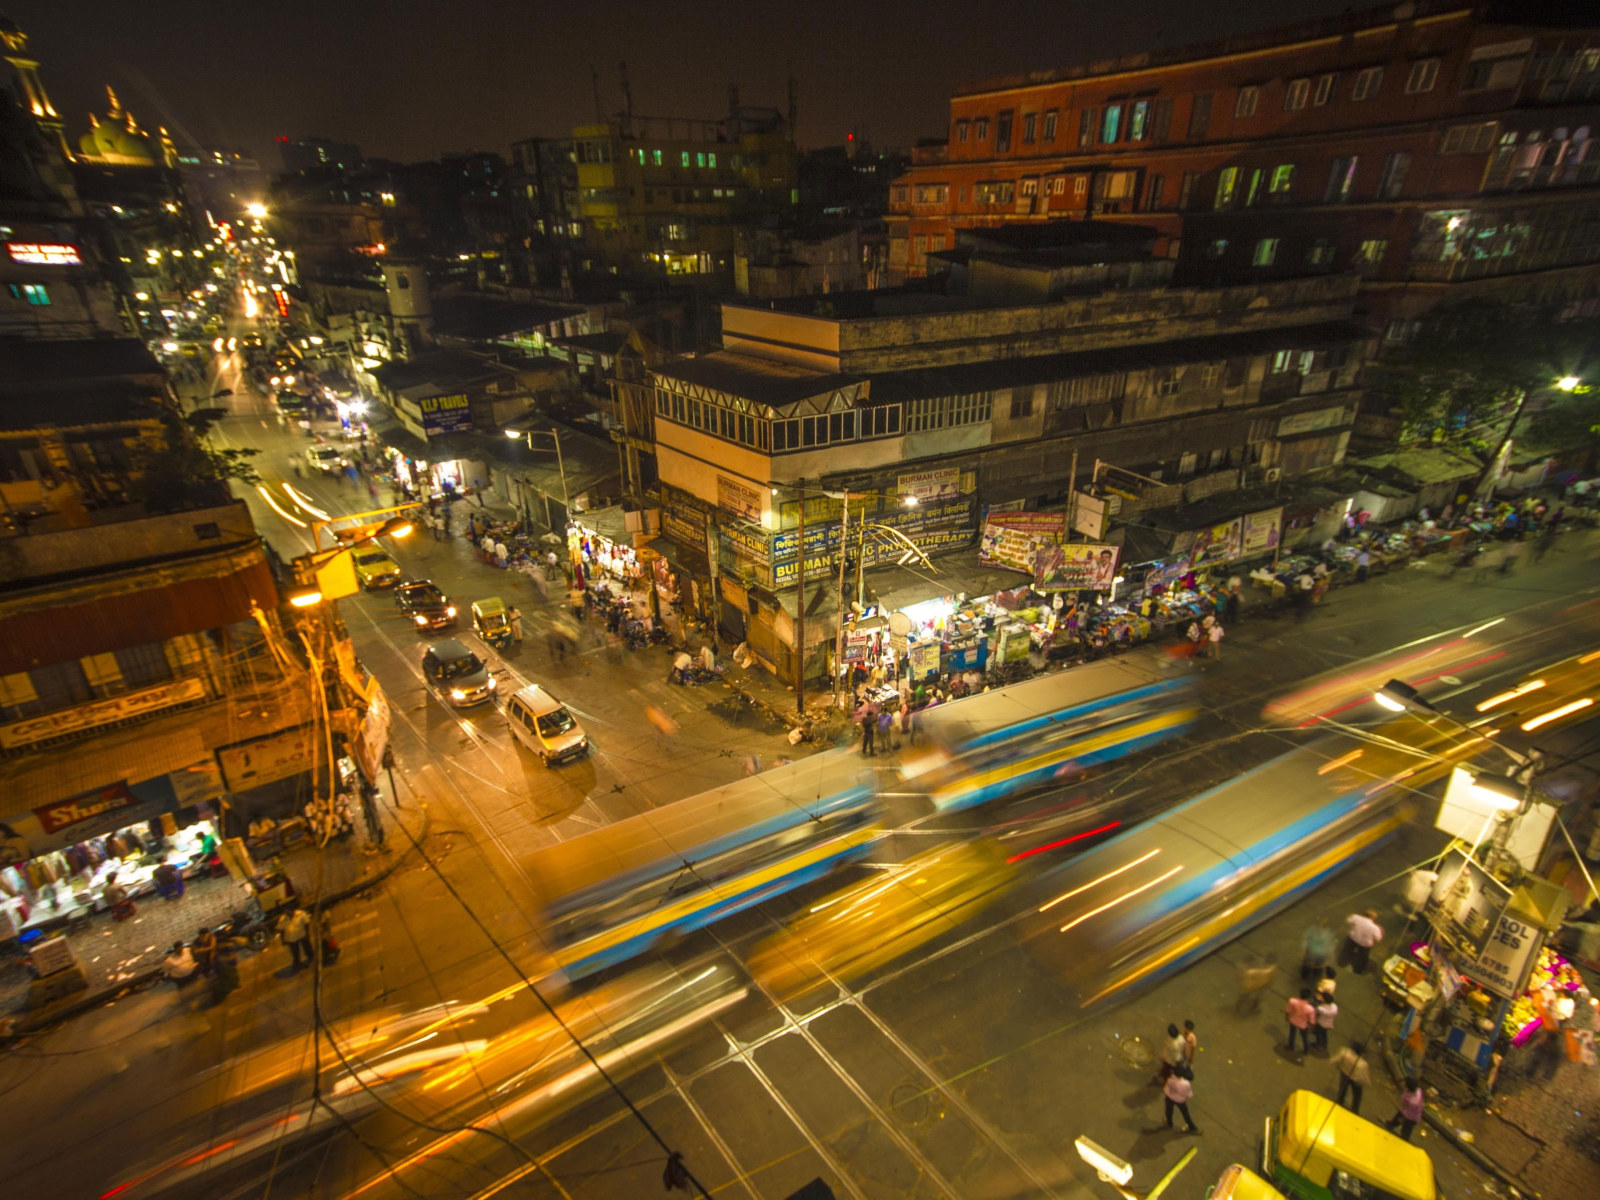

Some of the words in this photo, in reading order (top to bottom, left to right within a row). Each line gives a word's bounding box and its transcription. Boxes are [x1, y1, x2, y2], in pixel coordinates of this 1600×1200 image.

[900, 475, 933, 485] BURMAN
[934, 468, 958, 480] CLINIC
[747, 536, 769, 555] CLINIC
[878, 533, 973, 553] PHYSOTHERAPY
[1500, 915, 1529, 939] ROL
